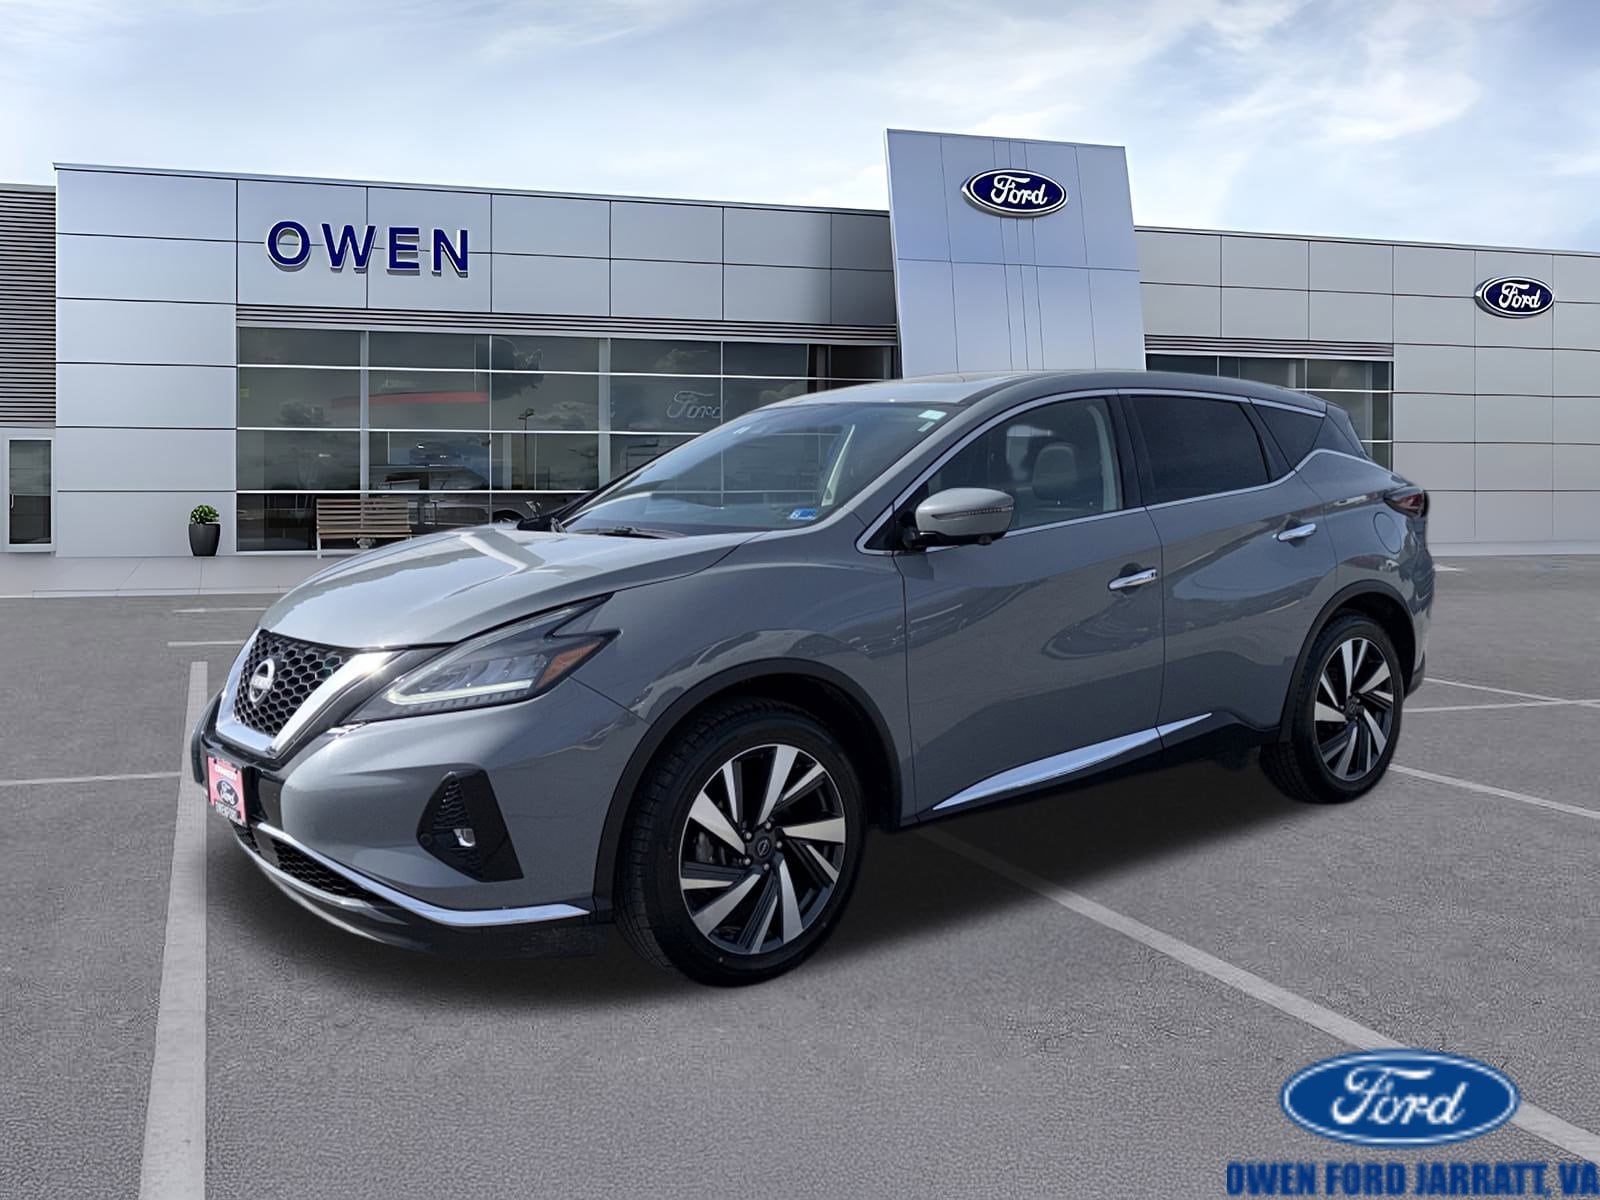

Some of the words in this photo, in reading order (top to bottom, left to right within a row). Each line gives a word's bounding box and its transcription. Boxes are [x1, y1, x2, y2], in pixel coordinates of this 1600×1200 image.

[990, 174, 1048, 205] Ford
[266, 220, 469, 278] OWEN
[1498, 282, 1541, 309] Ford
